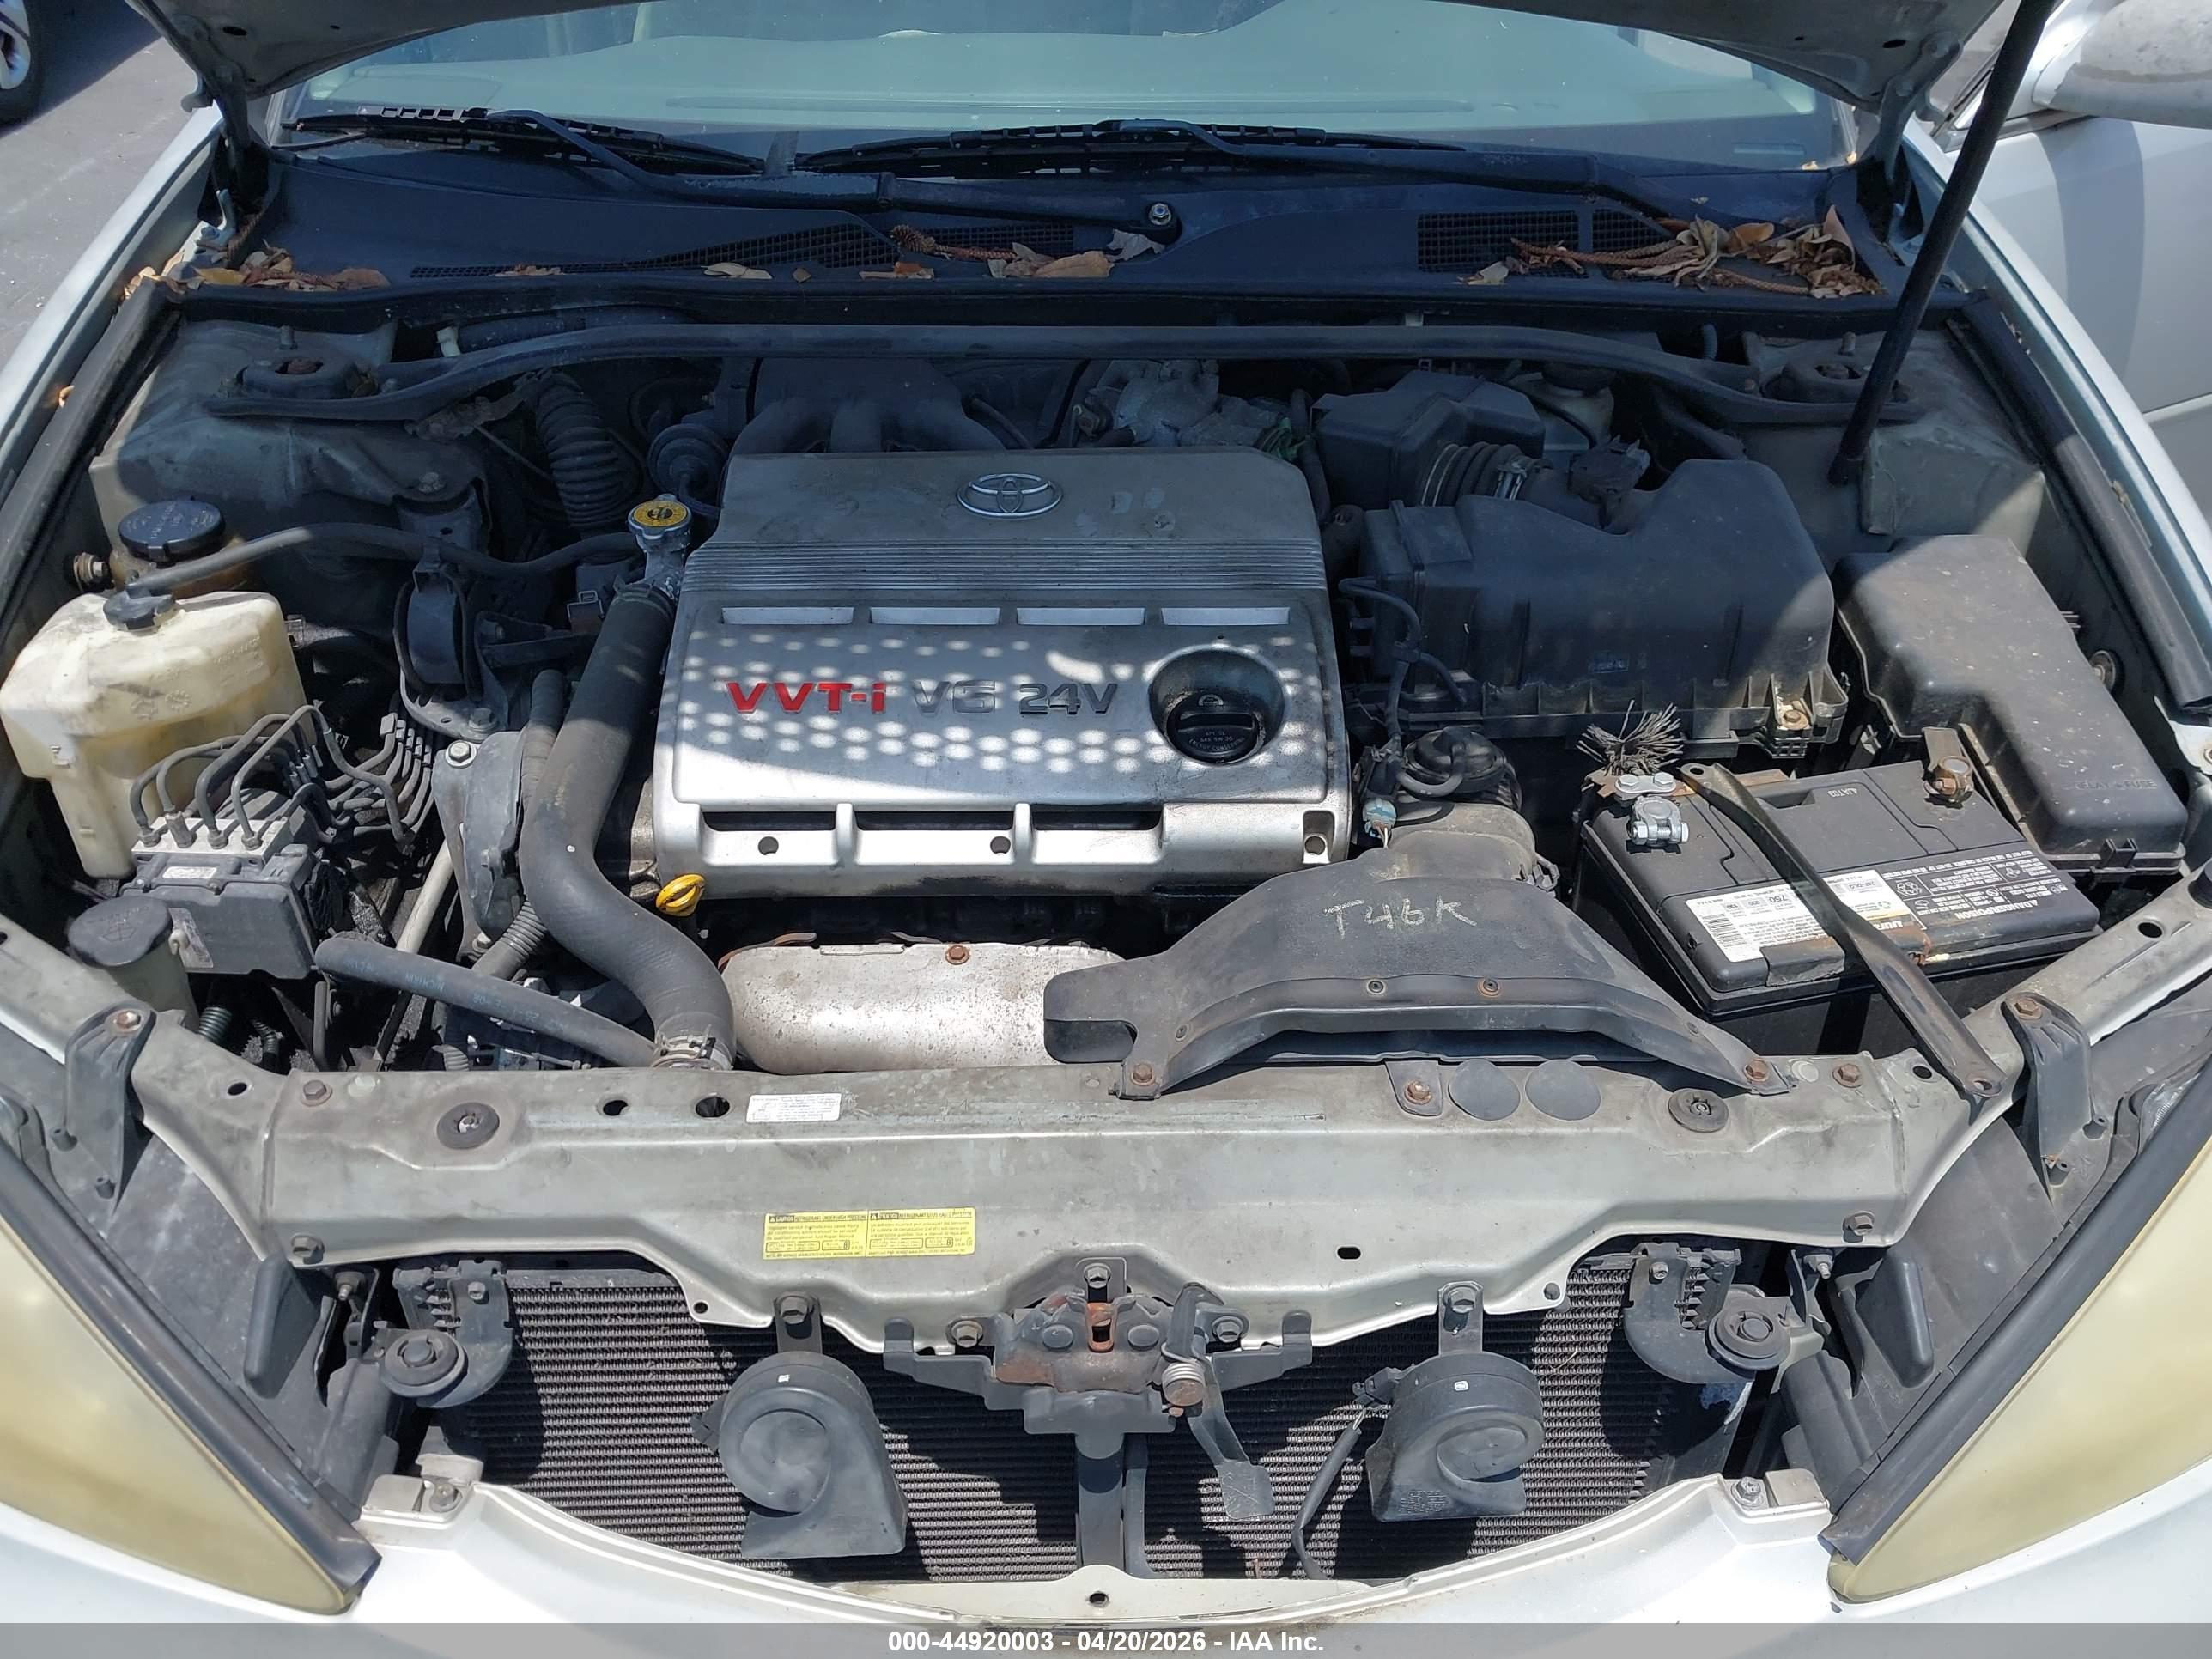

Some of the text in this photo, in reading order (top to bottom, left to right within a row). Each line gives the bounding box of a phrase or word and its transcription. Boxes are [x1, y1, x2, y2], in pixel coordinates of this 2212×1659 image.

[728, 680, 1117, 715] VVT-i V6 24V
[1768, 894, 1788, 903] 750
